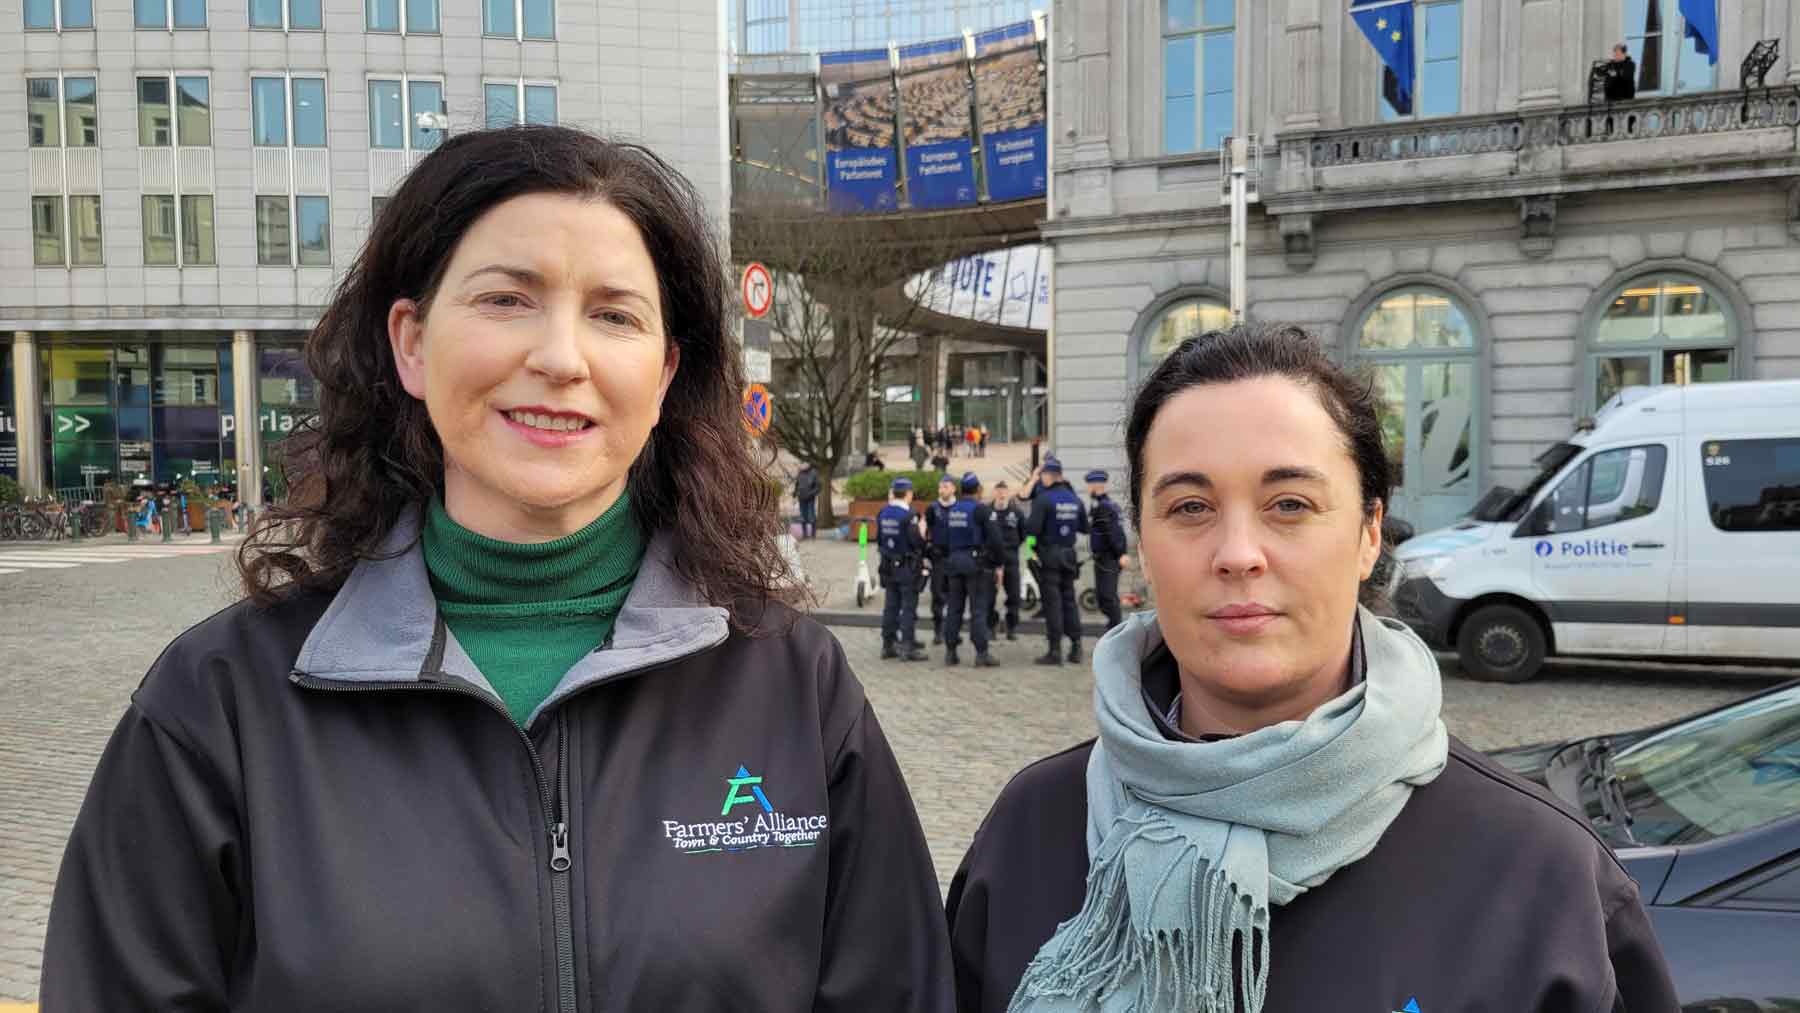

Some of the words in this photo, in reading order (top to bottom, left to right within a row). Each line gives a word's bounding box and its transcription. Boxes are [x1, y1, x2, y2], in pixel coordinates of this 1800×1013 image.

[1561, 539, 1630, 557] Politie
[662, 816, 749, 838] Farmers'
[754, 812, 828, 833] Alliance
[673, 837, 706, 848] Town
[709, 834, 720, 846] &
[722, 831, 770, 845] Country
[773, 829, 821, 844] Together
